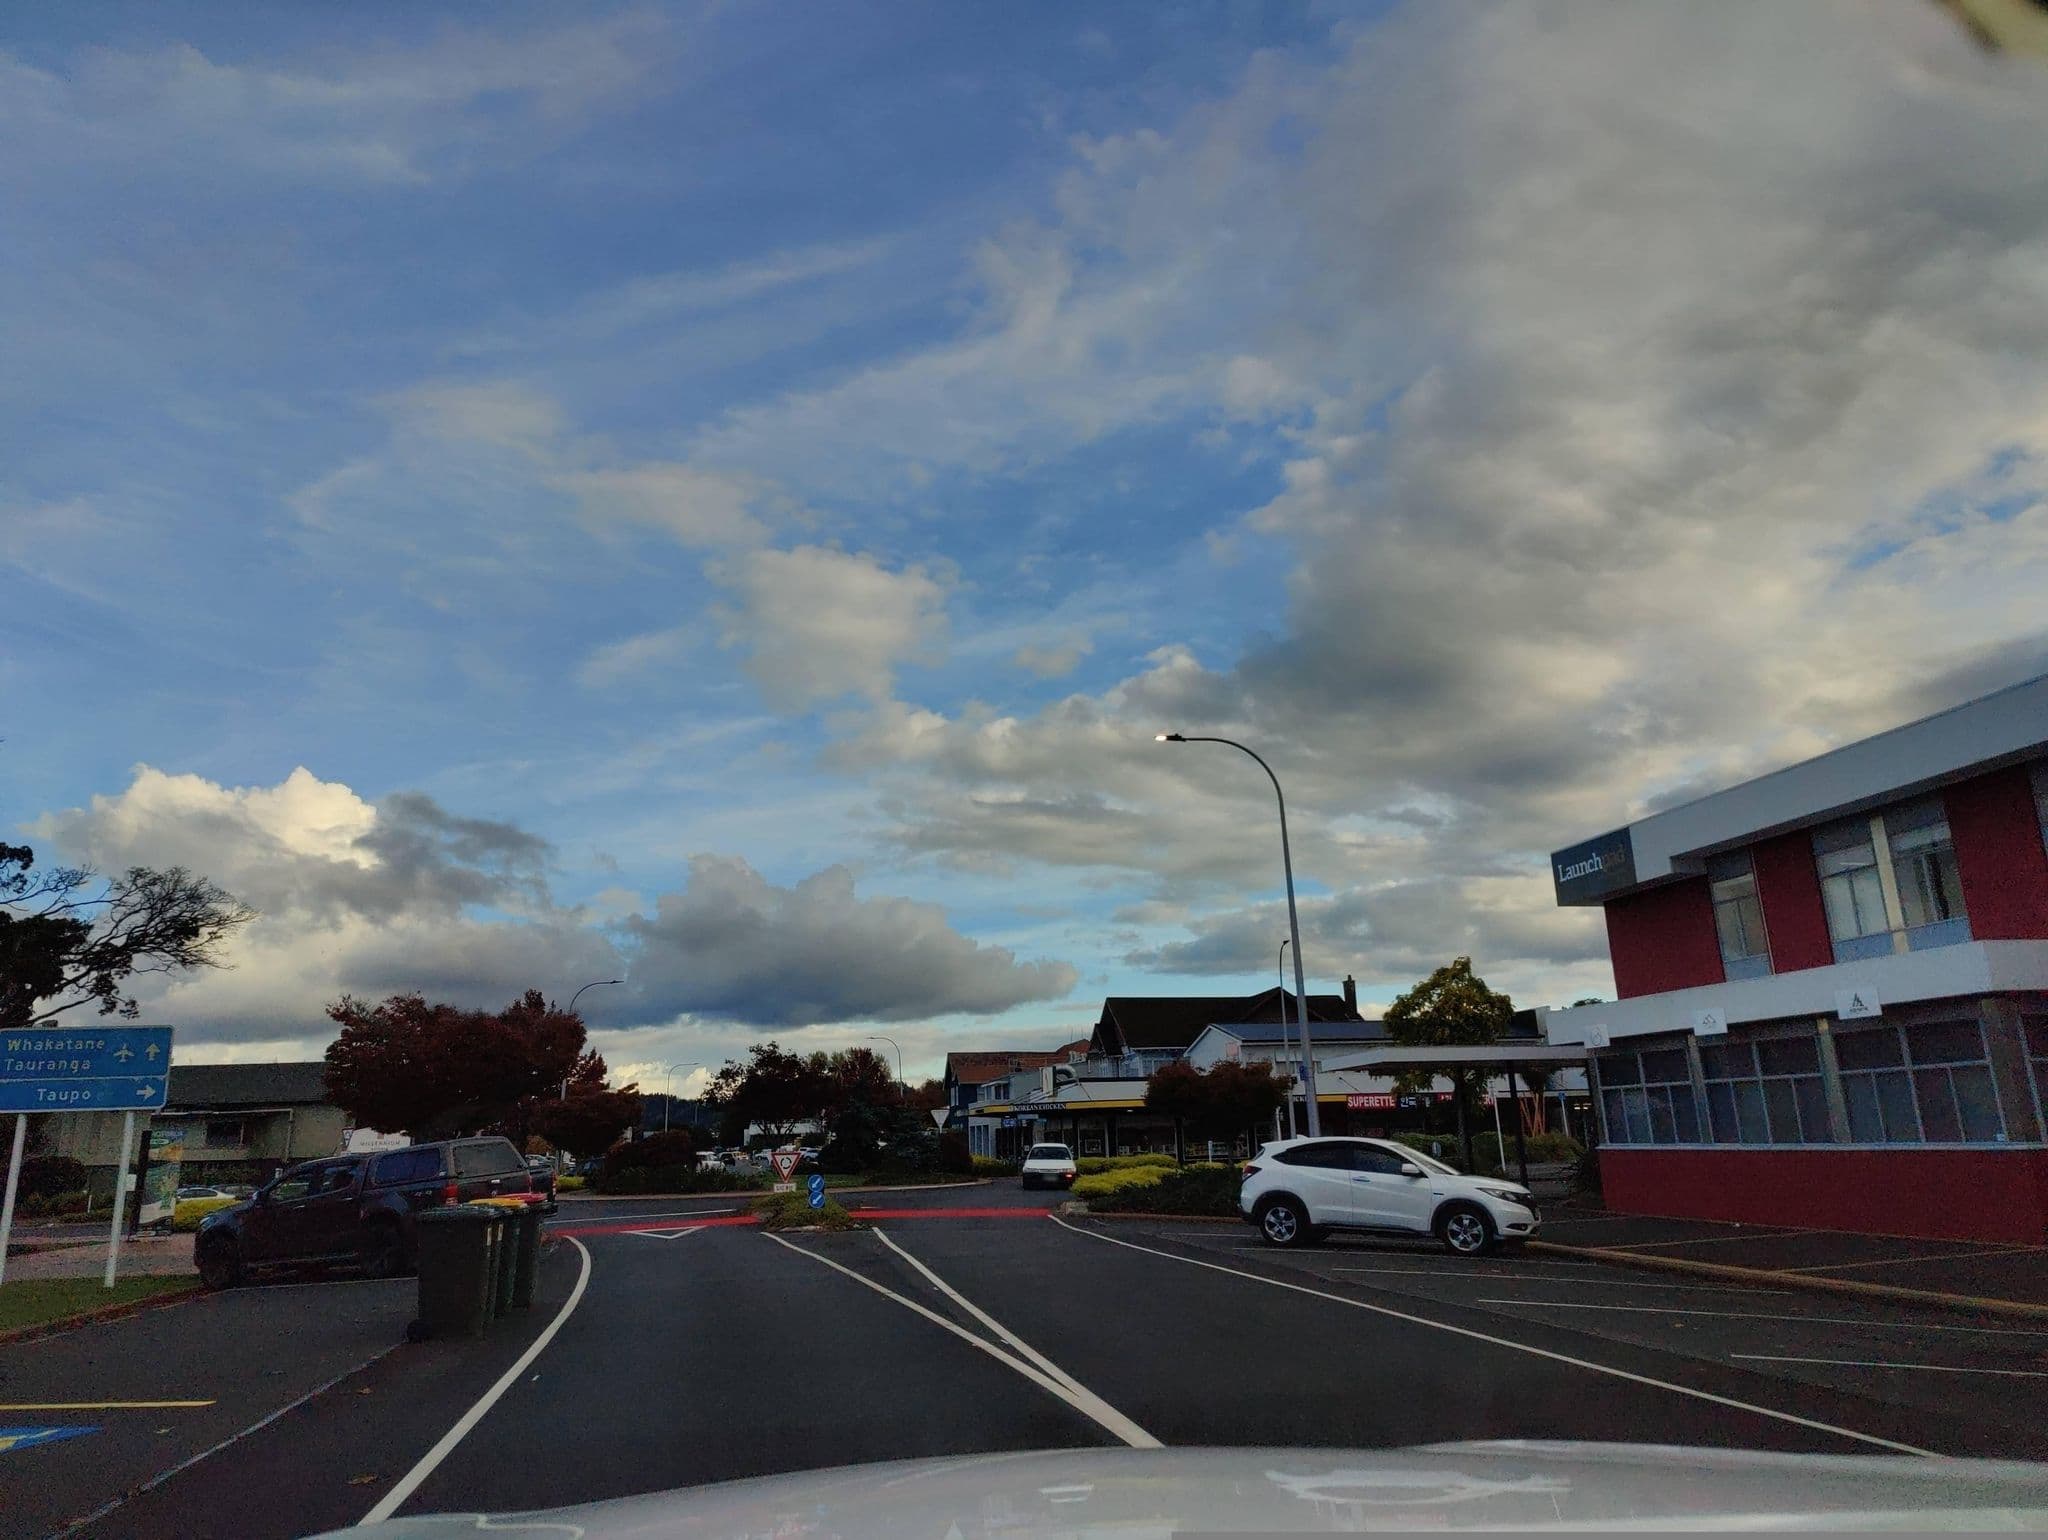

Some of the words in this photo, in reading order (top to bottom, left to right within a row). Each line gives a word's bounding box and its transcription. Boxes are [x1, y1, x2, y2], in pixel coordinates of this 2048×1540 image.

[7, 1038, 106, 1051] Whakatane
[5, 1058, 92, 1073] Tauranga
[37, 1088, 92, 1104] Taupo
[1347, 1095, 1396, 1108] SUPERETTE
